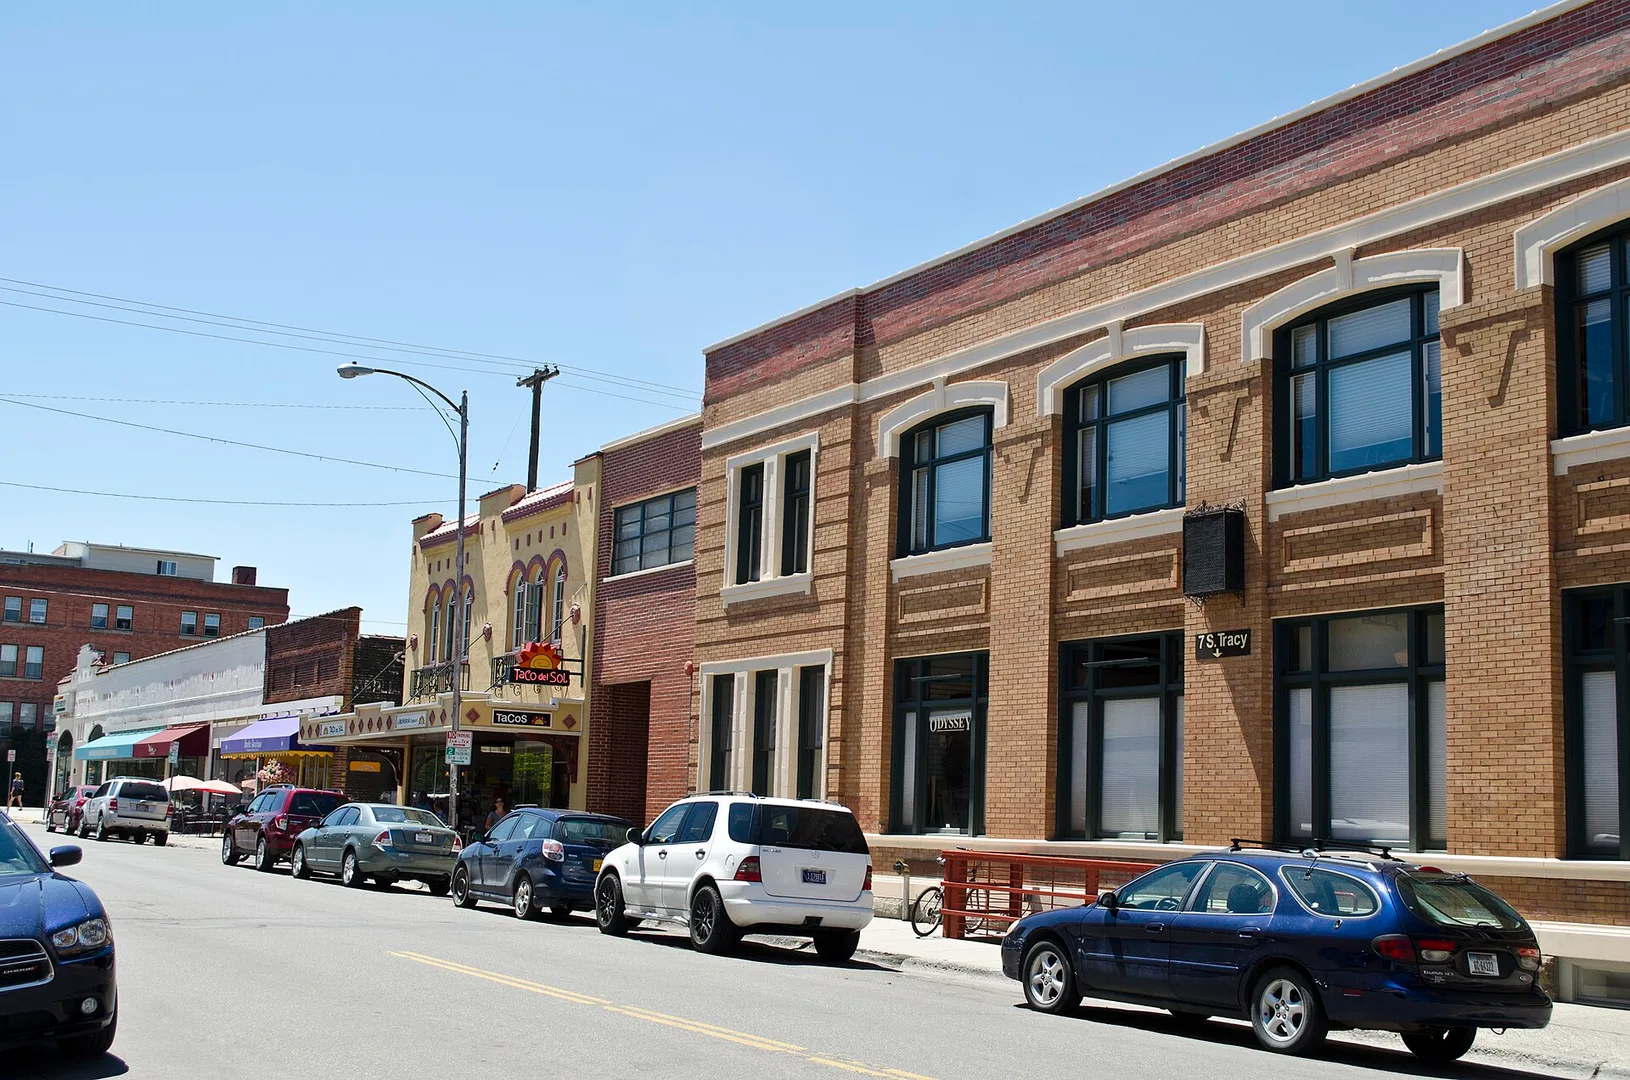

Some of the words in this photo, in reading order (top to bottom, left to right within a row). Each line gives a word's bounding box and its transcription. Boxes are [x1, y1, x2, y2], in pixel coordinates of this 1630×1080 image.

[1198, 634, 1205, 649] 7
[1217, 633, 1248, 649] Tracy
[538, 673, 549, 681] del
[930, 717, 971, 732] ODYSSEY
